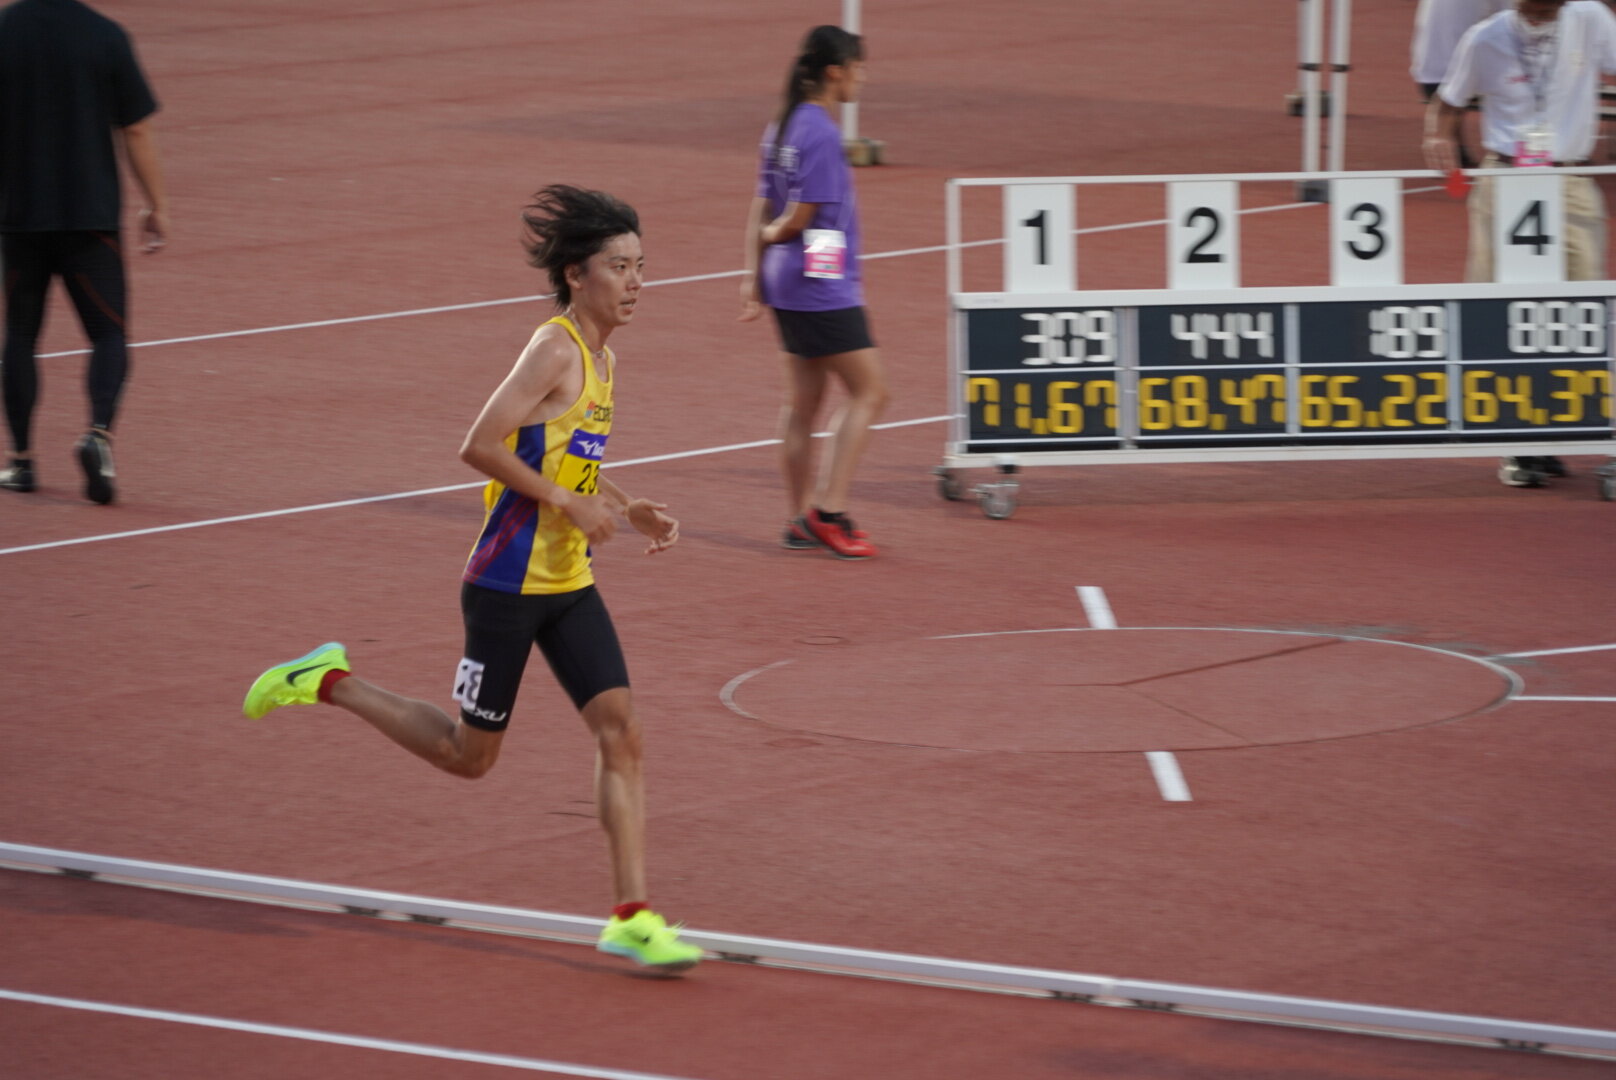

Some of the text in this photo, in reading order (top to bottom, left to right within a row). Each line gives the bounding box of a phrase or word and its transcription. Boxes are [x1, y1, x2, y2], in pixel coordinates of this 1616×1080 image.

[1022, 209, 1051, 265] 1
[1181, 207, 1226, 263] 2
[1344, 203, 1389, 260] 3
[1507, 200, 1554, 255] 4
[1021, 310, 1118, 365] 309
[1171, 312, 1274, 359] 444
[1507, 301, 1606, 353] 888
[965, 377, 1119, 433] 71.67
[1139, 374, 1286, 430] 68.47
[1299, 373, 1448, 428] 65.22
[1463, 370, 1611, 425] 64.37
